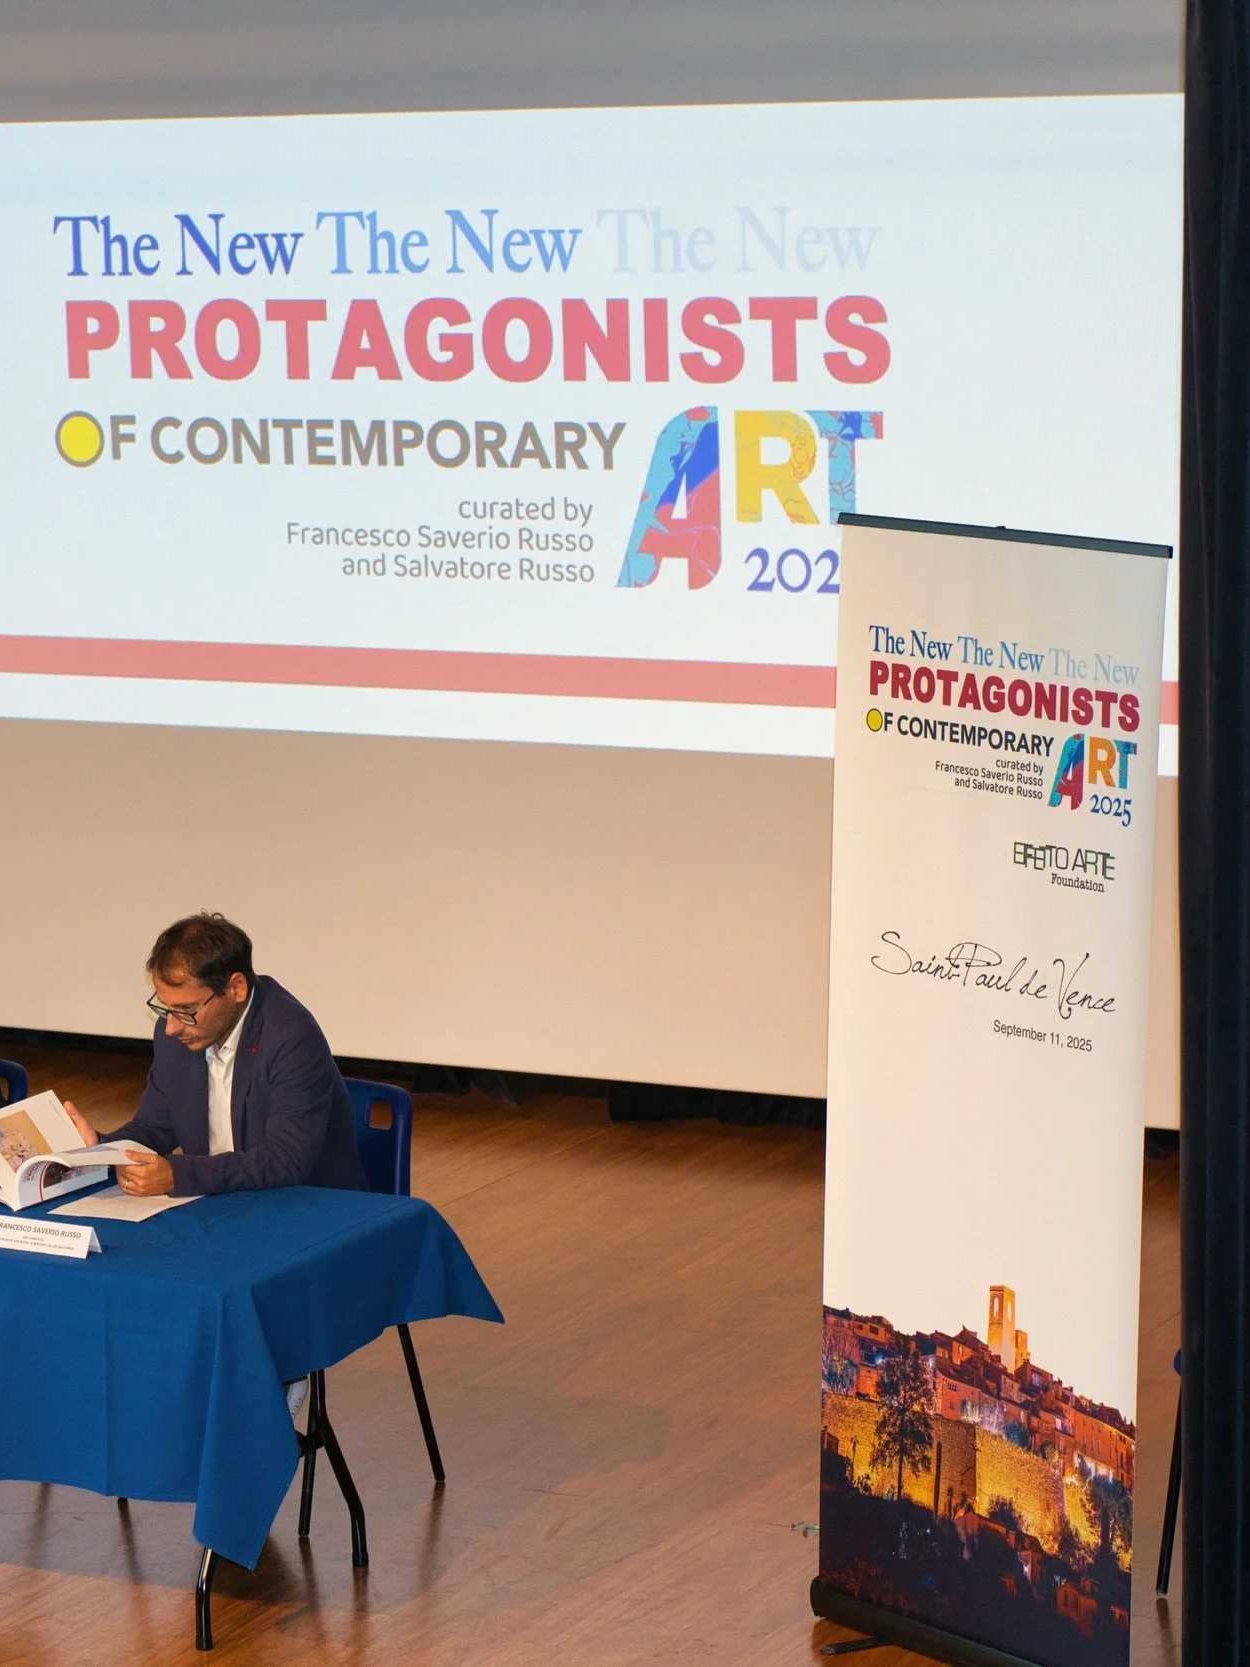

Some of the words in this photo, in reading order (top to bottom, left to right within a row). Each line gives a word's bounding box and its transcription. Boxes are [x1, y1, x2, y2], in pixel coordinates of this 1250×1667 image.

[53, 214, 161, 277] The
[175, 212, 304, 276] New
[316, 210, 430, 275] The
[445, 208, 583, 274] New
[597, 207, 732, 274] The
[735, 206, 882, 273] New
[65, 295, 891, 384] PROTAGONISTS
[55, 411, 137, 467] OF
[150, 416, 627, 470] CONTEMPORARY
[615, 405, 884, 590] ART
[458, 498, 557, 520] curated
[564, 498, 593, 527] by
[286, 522, 412, 548] Francesco
[417, 525, 511, 550] Saverio
[518, 528, 595, 552] Russo
[341, 553, 388, 578] and
[393, 554, 512, 582] Salvatore
[518, 558, 595, 583] Russo
[744, 547, 840, 594] 202
[869, 624, 906, 654] The
[910, 630, 953, 661] New
[957, 635, 994, 666] The
[998, 641, 1045, 673] New
[1048, 648, 1088, 679] The
[1093, 653, 1140, 686] New
[869, 660, 1141, 733] PROTAGONISTS
[866, 708, 894, 732] OF
[897, 715, 1055, 757] CONTEMPORARY
[1047, 733, 1138, 811] ART
[935, 760, 980, 777] Francesco
[981, 767, 1014, 783] Saverio
[1016, 773, 1044, 787] Russo
[995, 758, 1032, 773] curated
[1034, 762, 1044, 776] by
[954, 776, 971, 789] and
[972, 779, 1014, 796] Salvatore
[1016, 786, 1043, 800] Russo
[1090, 794, 1133, 827] 2025
[1071, 848, 1116, 881] ARTE
[1051, 873, 1105, 893] Foundation
[1019, 970, 1048, 999] de
[1053, 952, 1116, 1020] Vence
[993, 1019, 1047, 1042] September
[1050, 1032, 1064, 1048] 11,
[1066, 1035, 1093, 1052] 2025
[33, 1226, 60, 1236] SAVERIO
[61, 1230, 82, 1239] RUSSO
